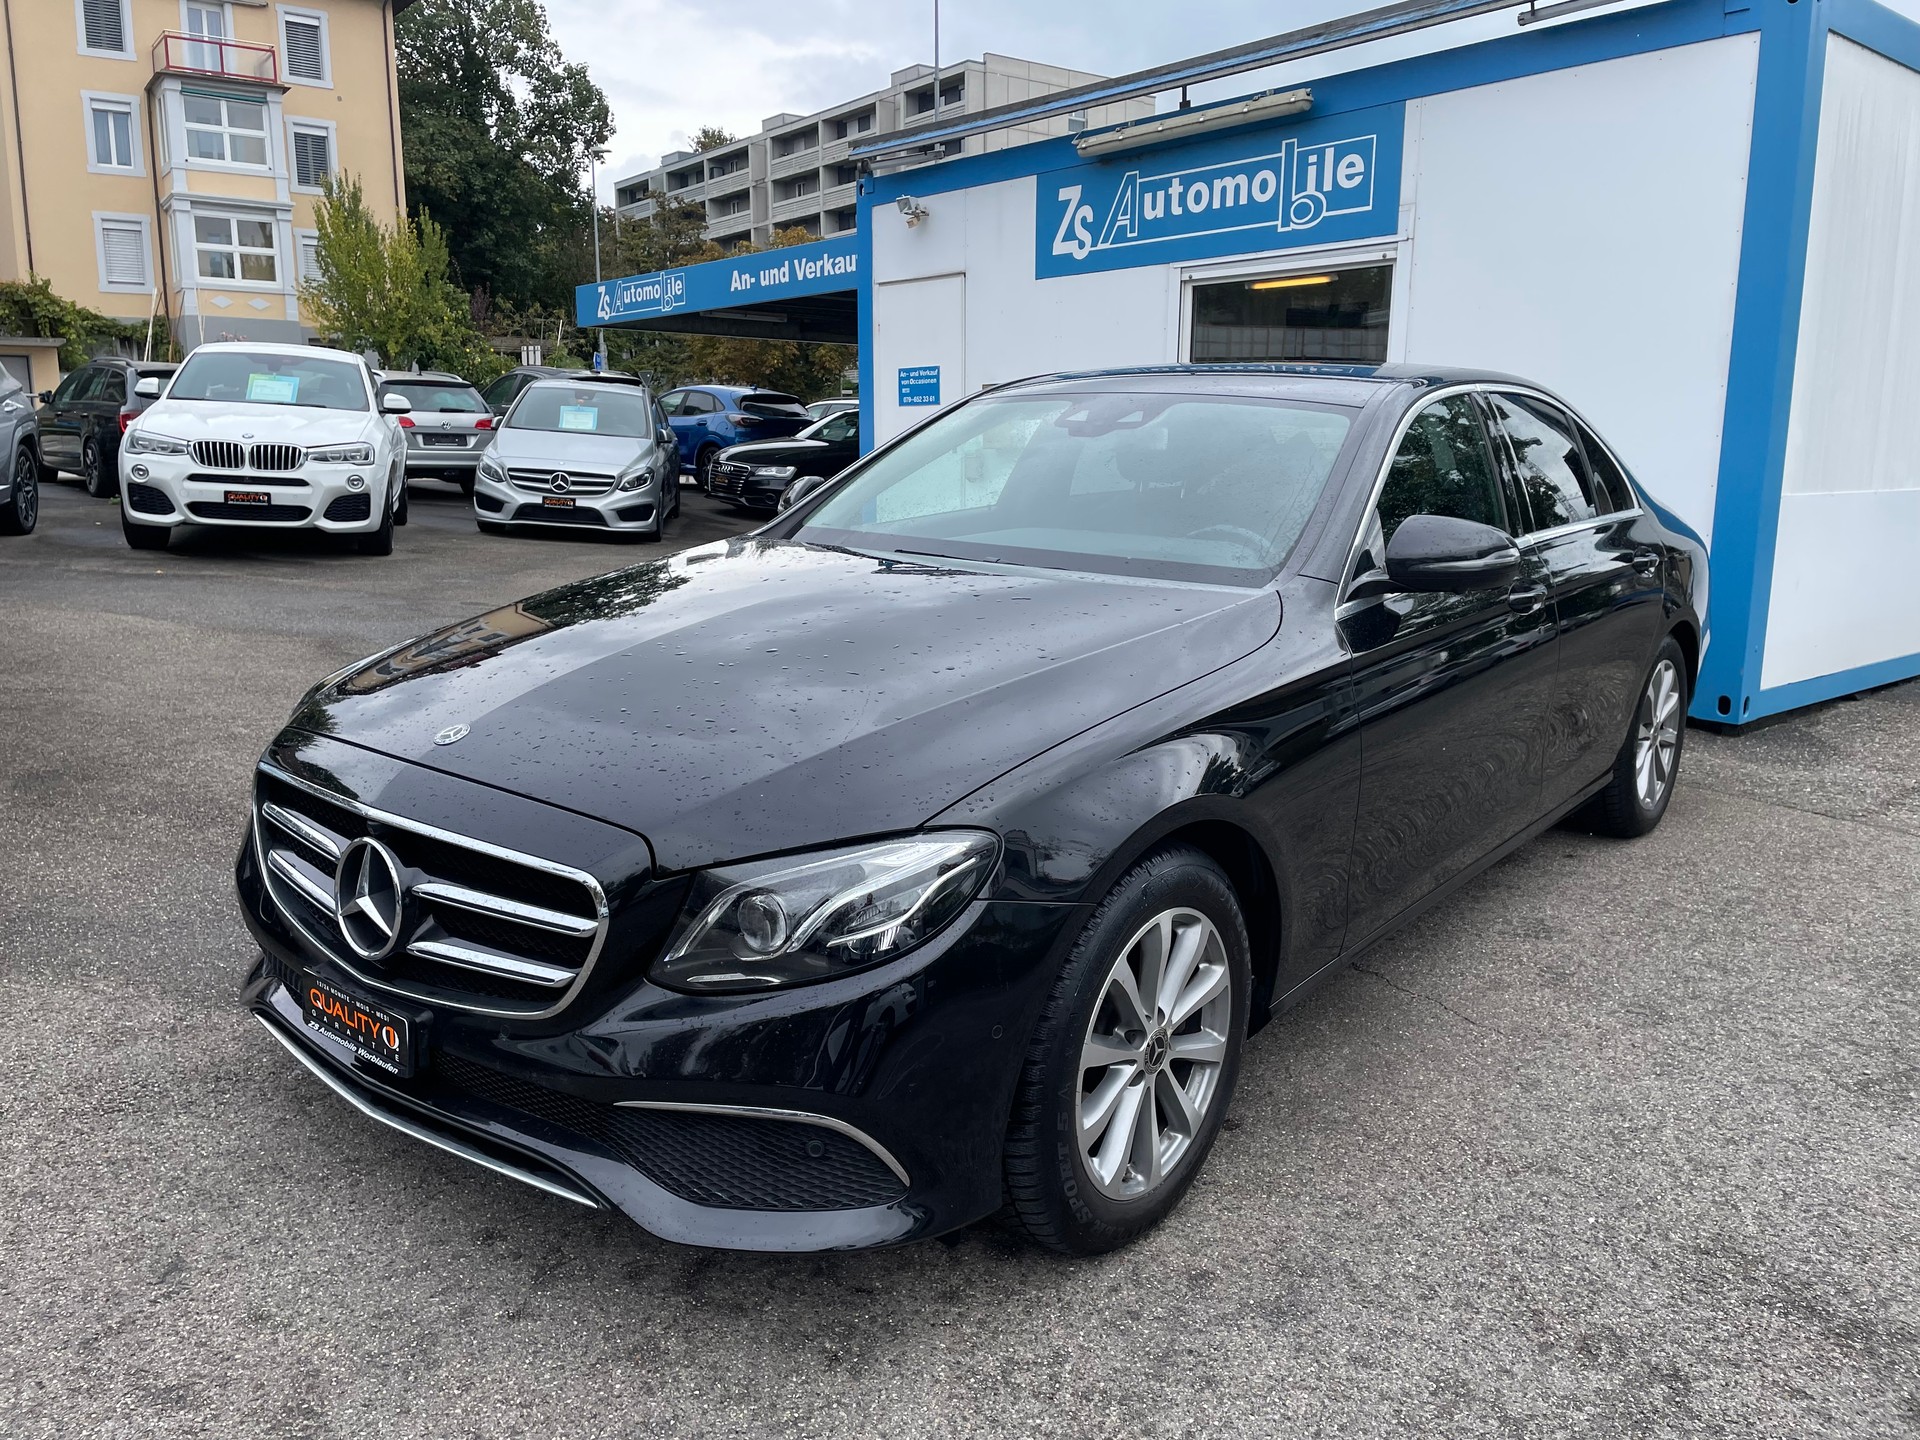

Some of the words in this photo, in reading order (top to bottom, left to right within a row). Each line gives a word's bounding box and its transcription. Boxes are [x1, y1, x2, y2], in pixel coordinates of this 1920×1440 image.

[1097, 138, 1365, 248] Automobile
[611, 272, 683, 315] Automobile
[730, 270, 756, 292] An-
[760, 261, 789, 286] und
[794, 253, 858, 281] Verkau
[310, 988, 381, 1039] QUALITY
[319, 1025, 358, 1052] Automobile
[357, 1047, 399, 1075] Worblaufen
